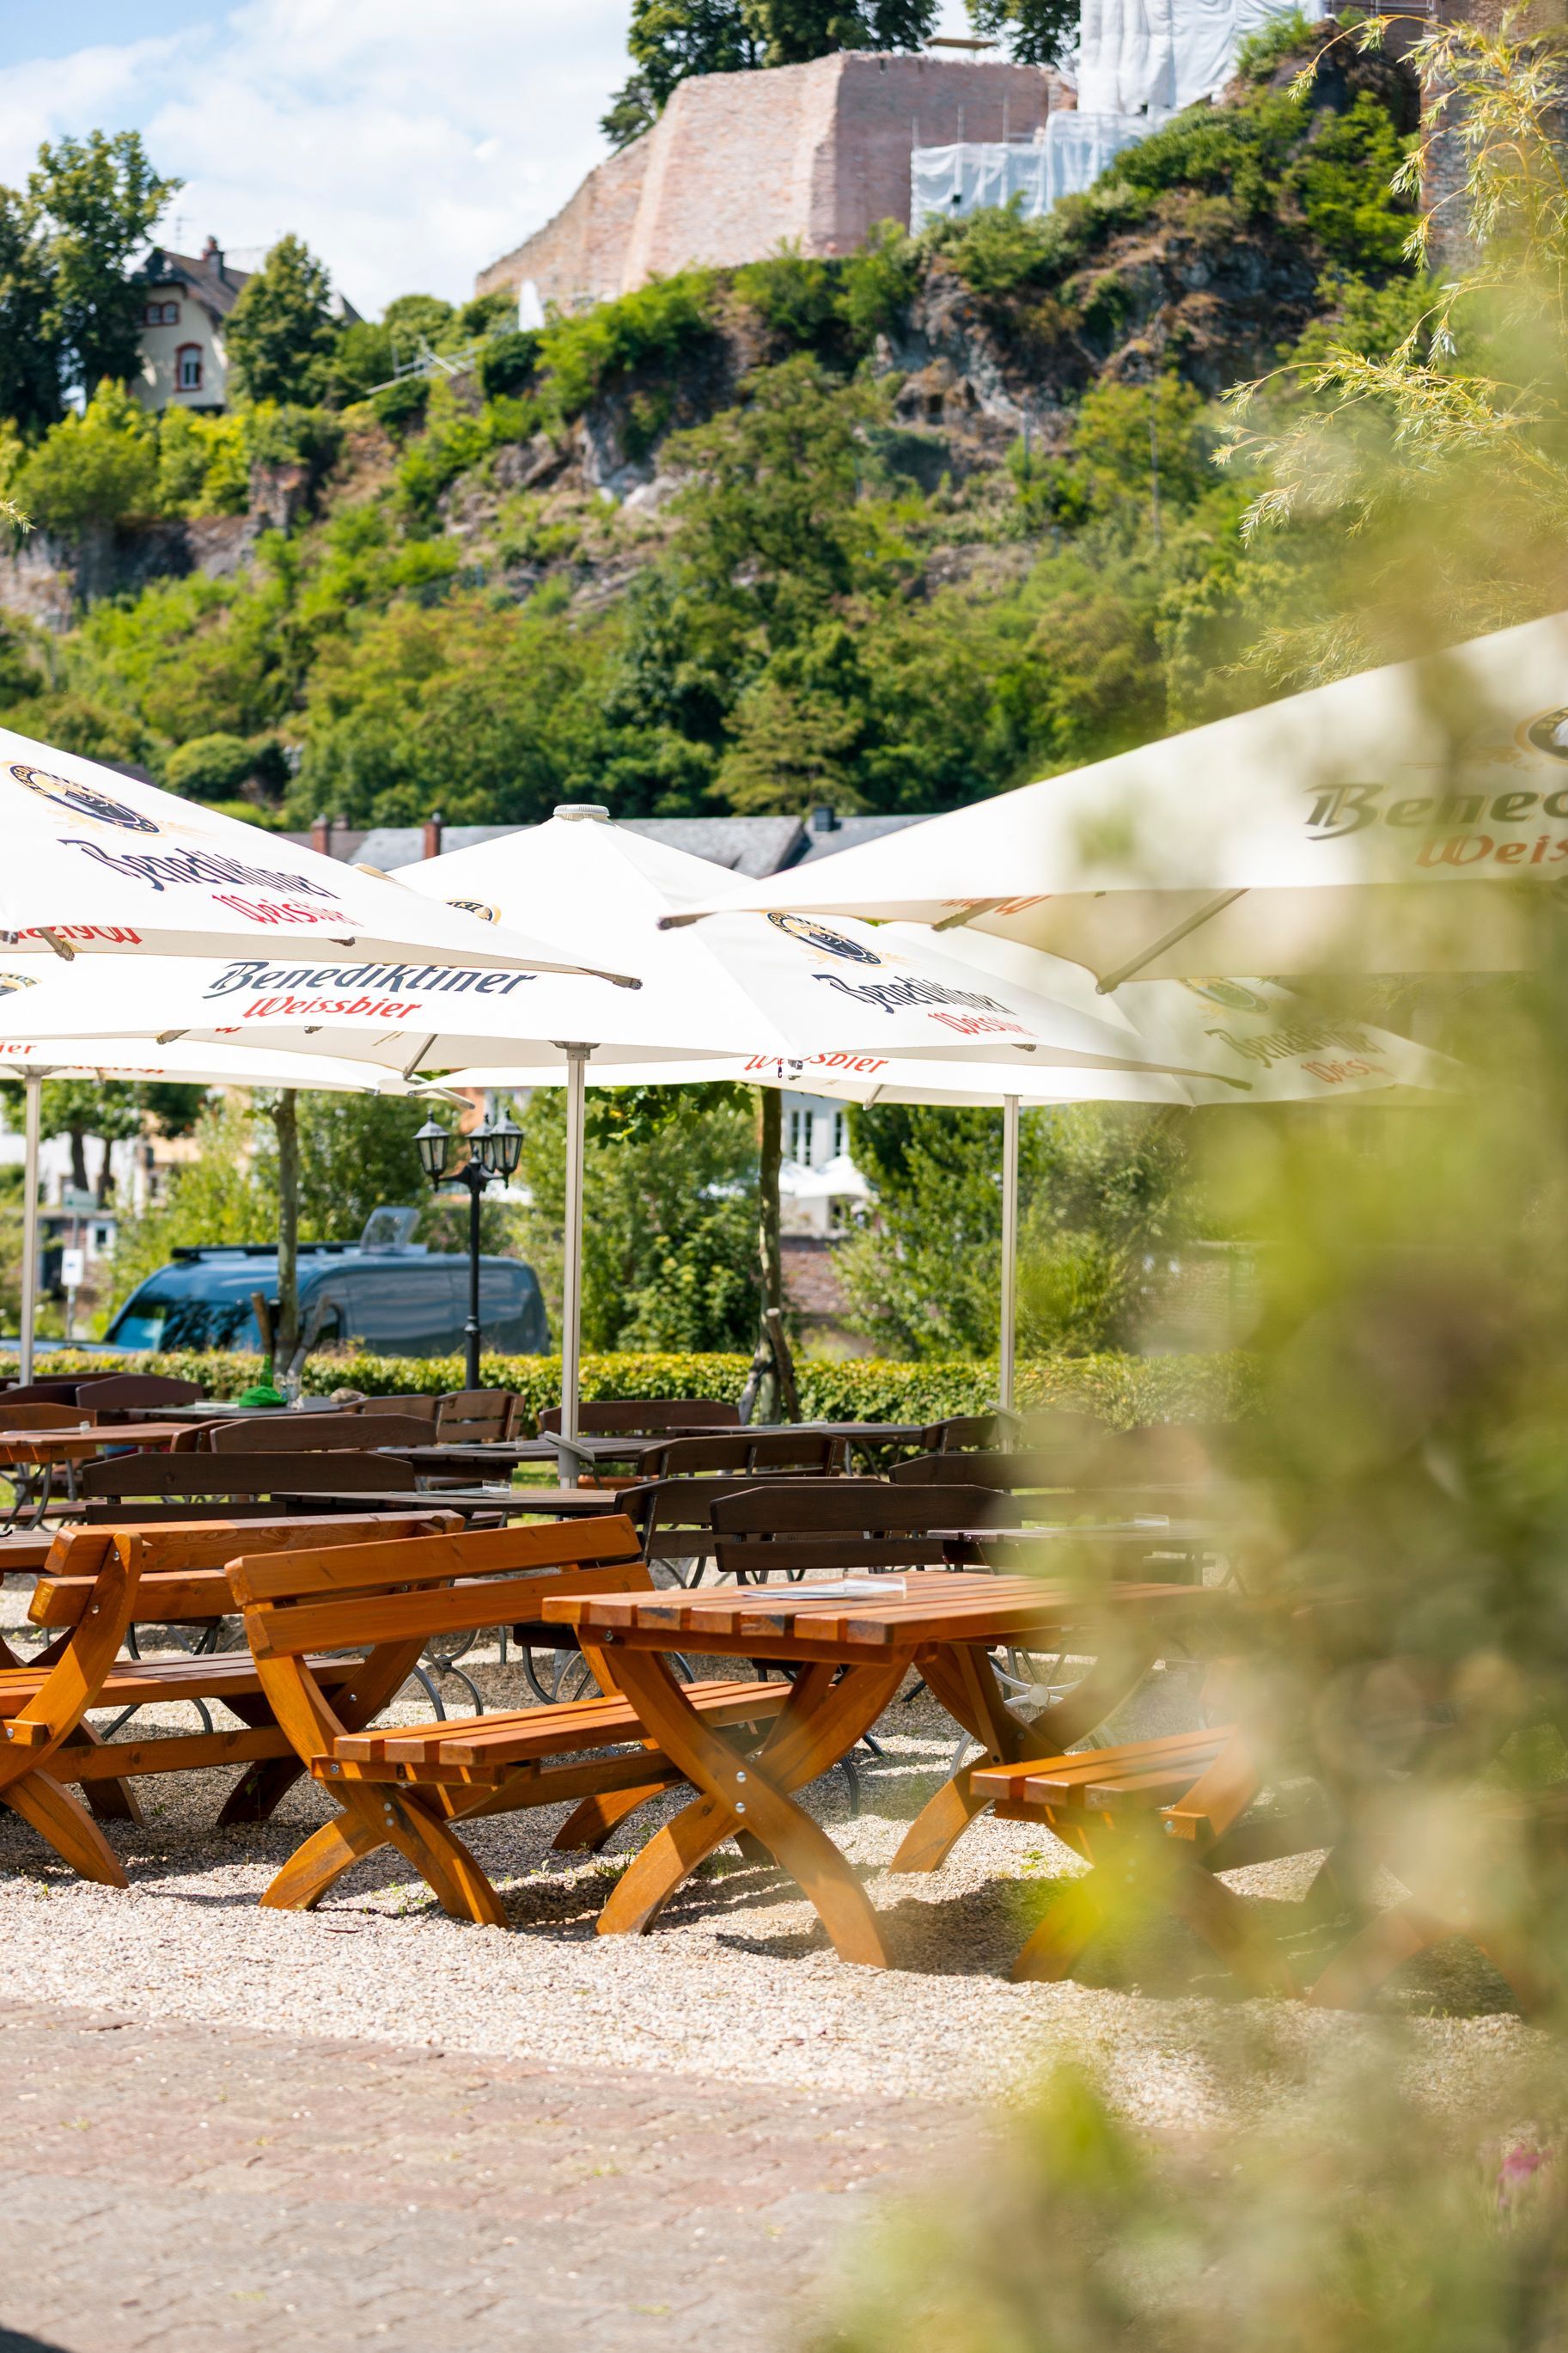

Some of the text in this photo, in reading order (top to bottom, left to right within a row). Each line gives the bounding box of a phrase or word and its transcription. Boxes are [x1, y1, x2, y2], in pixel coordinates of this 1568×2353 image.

[56, 838, 343, 900] Benediktiner
[202, 962, 539, 999] Benediktiner
[242, 995, 423, 1018] Weissbier
